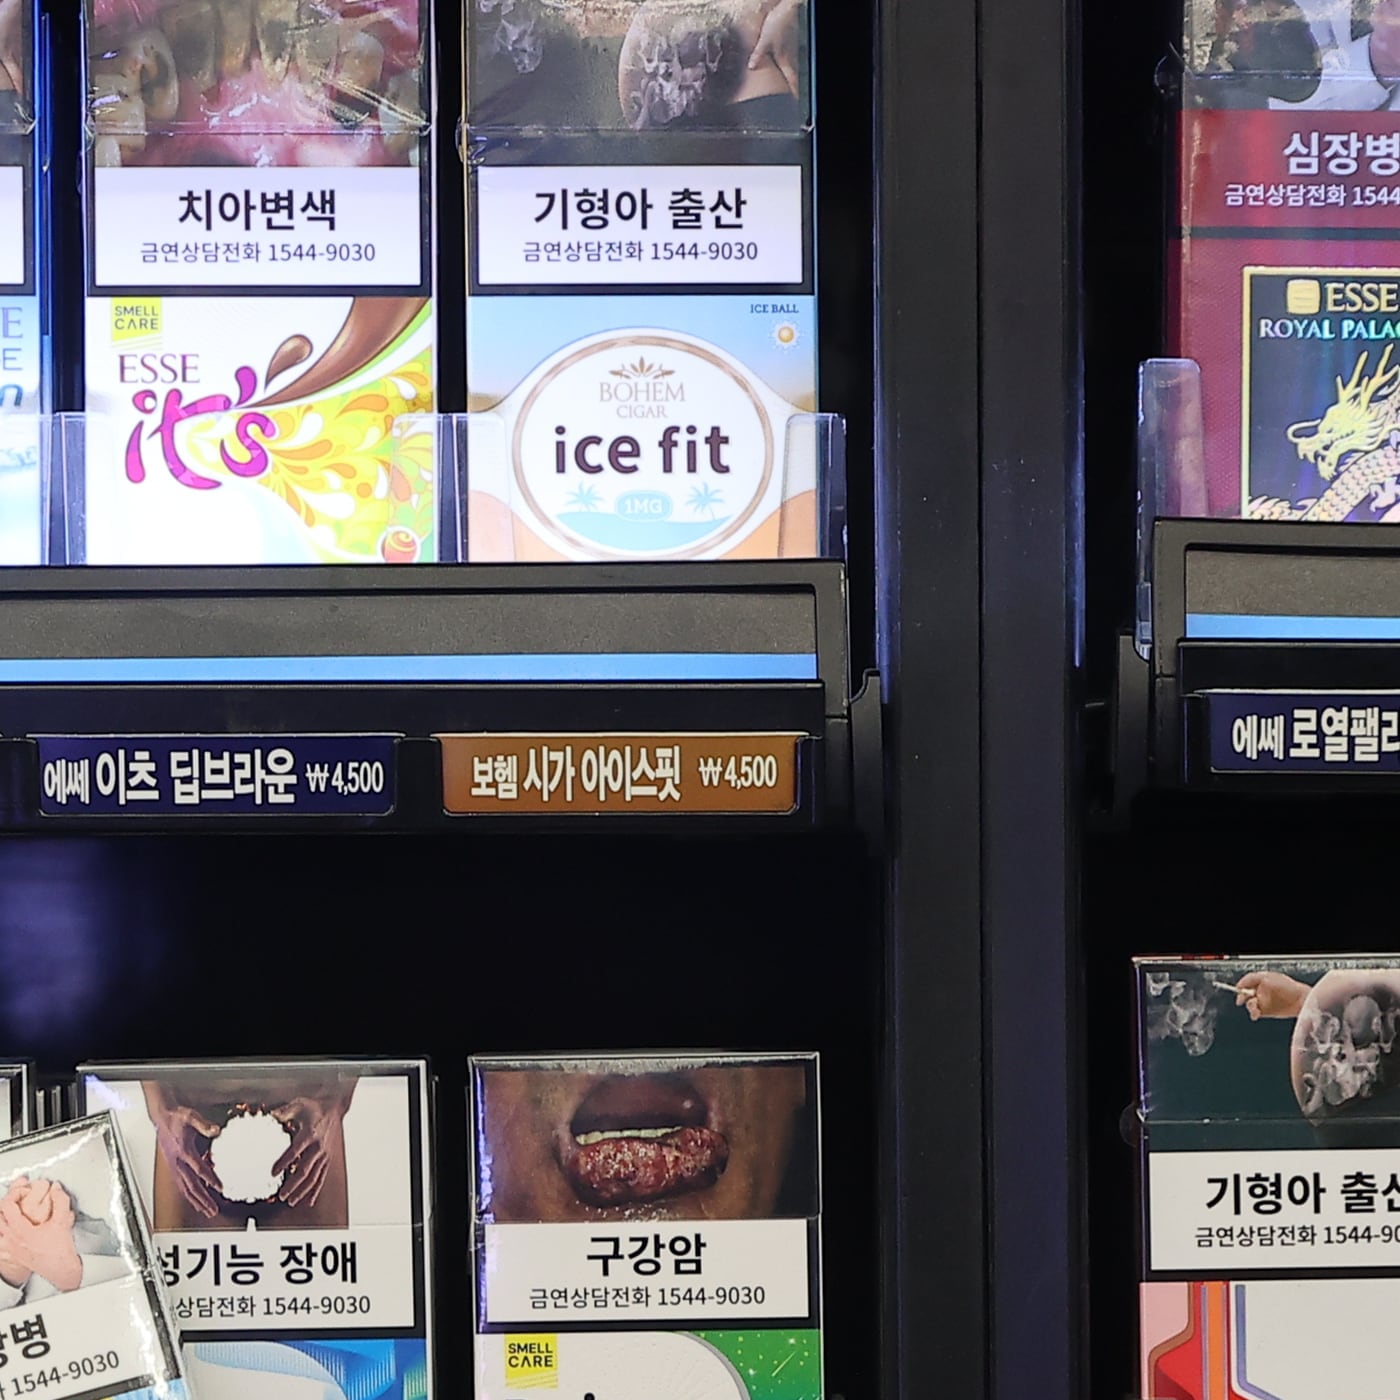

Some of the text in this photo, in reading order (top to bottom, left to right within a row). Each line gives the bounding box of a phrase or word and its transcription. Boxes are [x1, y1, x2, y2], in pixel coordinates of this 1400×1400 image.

[1283, 132, 1400, 175] 심장병
[179, 189, 335, 231] 치아변색
[535, 188, 747, 230] 기형아 출산
[524, 241, 758, 262] 금연상담전화 1544-9030
[751, 304, 799, 313] ICE BALL
[1325, 283, 1398, 312] ESSE
[1260, 319, 1400, 339] ROYAL PALAC
[119, 354, 199, 383] ESSE
[600, 382, 685, 402] BOHEM
[616, 405, 668, 419] CIGAR
[120, 362, 279, 490] it's
[555, 425, 730, 474] ice fit
[625, 498, 662, 514] 1MG
[1233, 715, 1284, 759] 에쎄
[44, 749, 383, 804] 에쎄 이츠 딥브라운 ₩4,500
[472, 746, 776, 801] 보헴 시가 아이스핏 ₩4,500
[1206, 1172, 1326, 1215] 기형아
[587, 1233, 706, 1276] 구강암
[530, 1286, 765, 1309] 금연상담전화 1544-9030
[11, 1349, 120, 1397] 1544-9030
